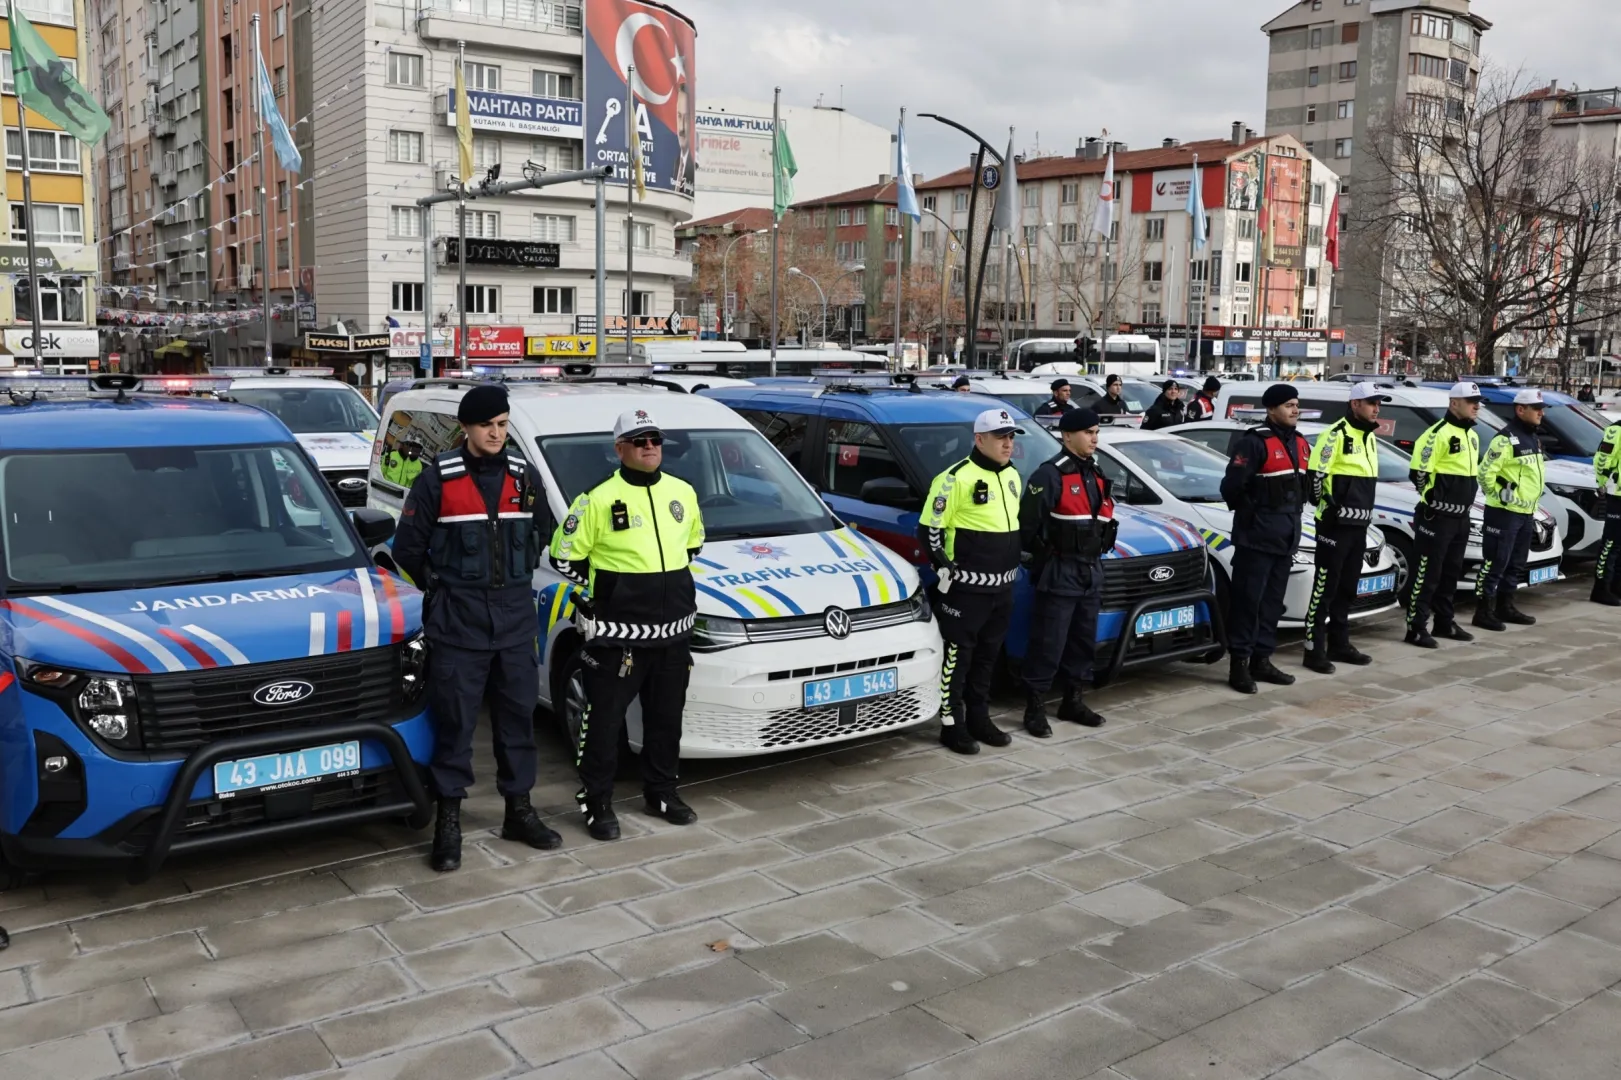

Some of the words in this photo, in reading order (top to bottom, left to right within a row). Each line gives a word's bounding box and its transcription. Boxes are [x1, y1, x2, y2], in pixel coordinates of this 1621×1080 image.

[453, 97, 532, 118] NAHTAR
[12, 256, 53, 267] KUSU
[551, 340, 574, 351] 7/24
[707, 564, 802, 588] TRAFİK
[801, 558, 880, 577] POLİSİ
[129, 584, 331, 612] JANDARMA
[1141, 615, 1153, 631] 43
[1157, 611, 1173, 628] JAA
[1178, 608, 1193, 624] 056
[264, 683, 303, 702] Ford
[814, 682, 832, 702] 43
[843, 678, 851, 697] A
[863, 671, 895, 693] 5443
[230, 762, 257, 787] 43
[270, 753, 308, 781] JAA
[320, 745, 357, 771] 099
